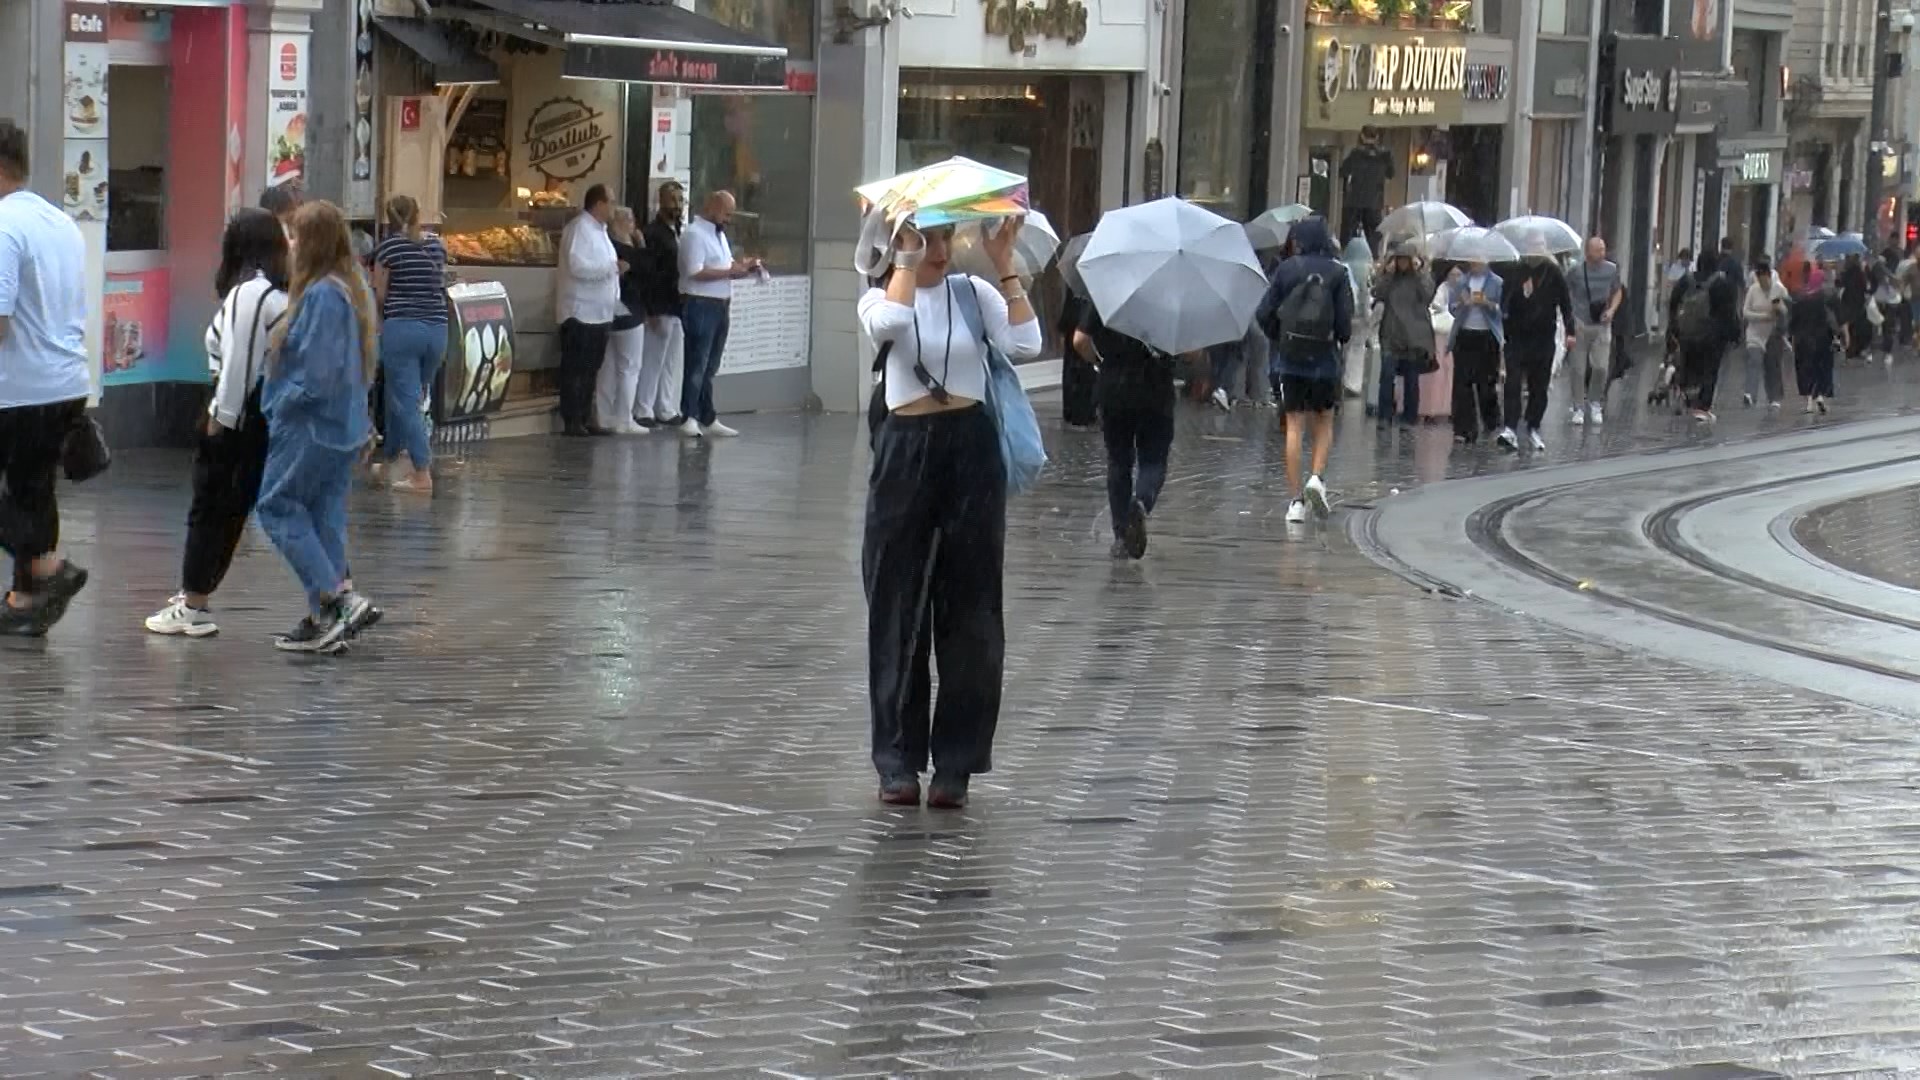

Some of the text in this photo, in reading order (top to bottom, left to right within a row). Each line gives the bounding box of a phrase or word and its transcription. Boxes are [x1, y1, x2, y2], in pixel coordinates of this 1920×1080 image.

[1346, 44, 1400, 90] KBAP
[1401, 36, 1467, 90] DÜNYASI
[1624, 67, 1661, 112] SuperStep
[529, 120, 602, 161] Dostluk
[1743, 152, 1769, 180] GUESS
